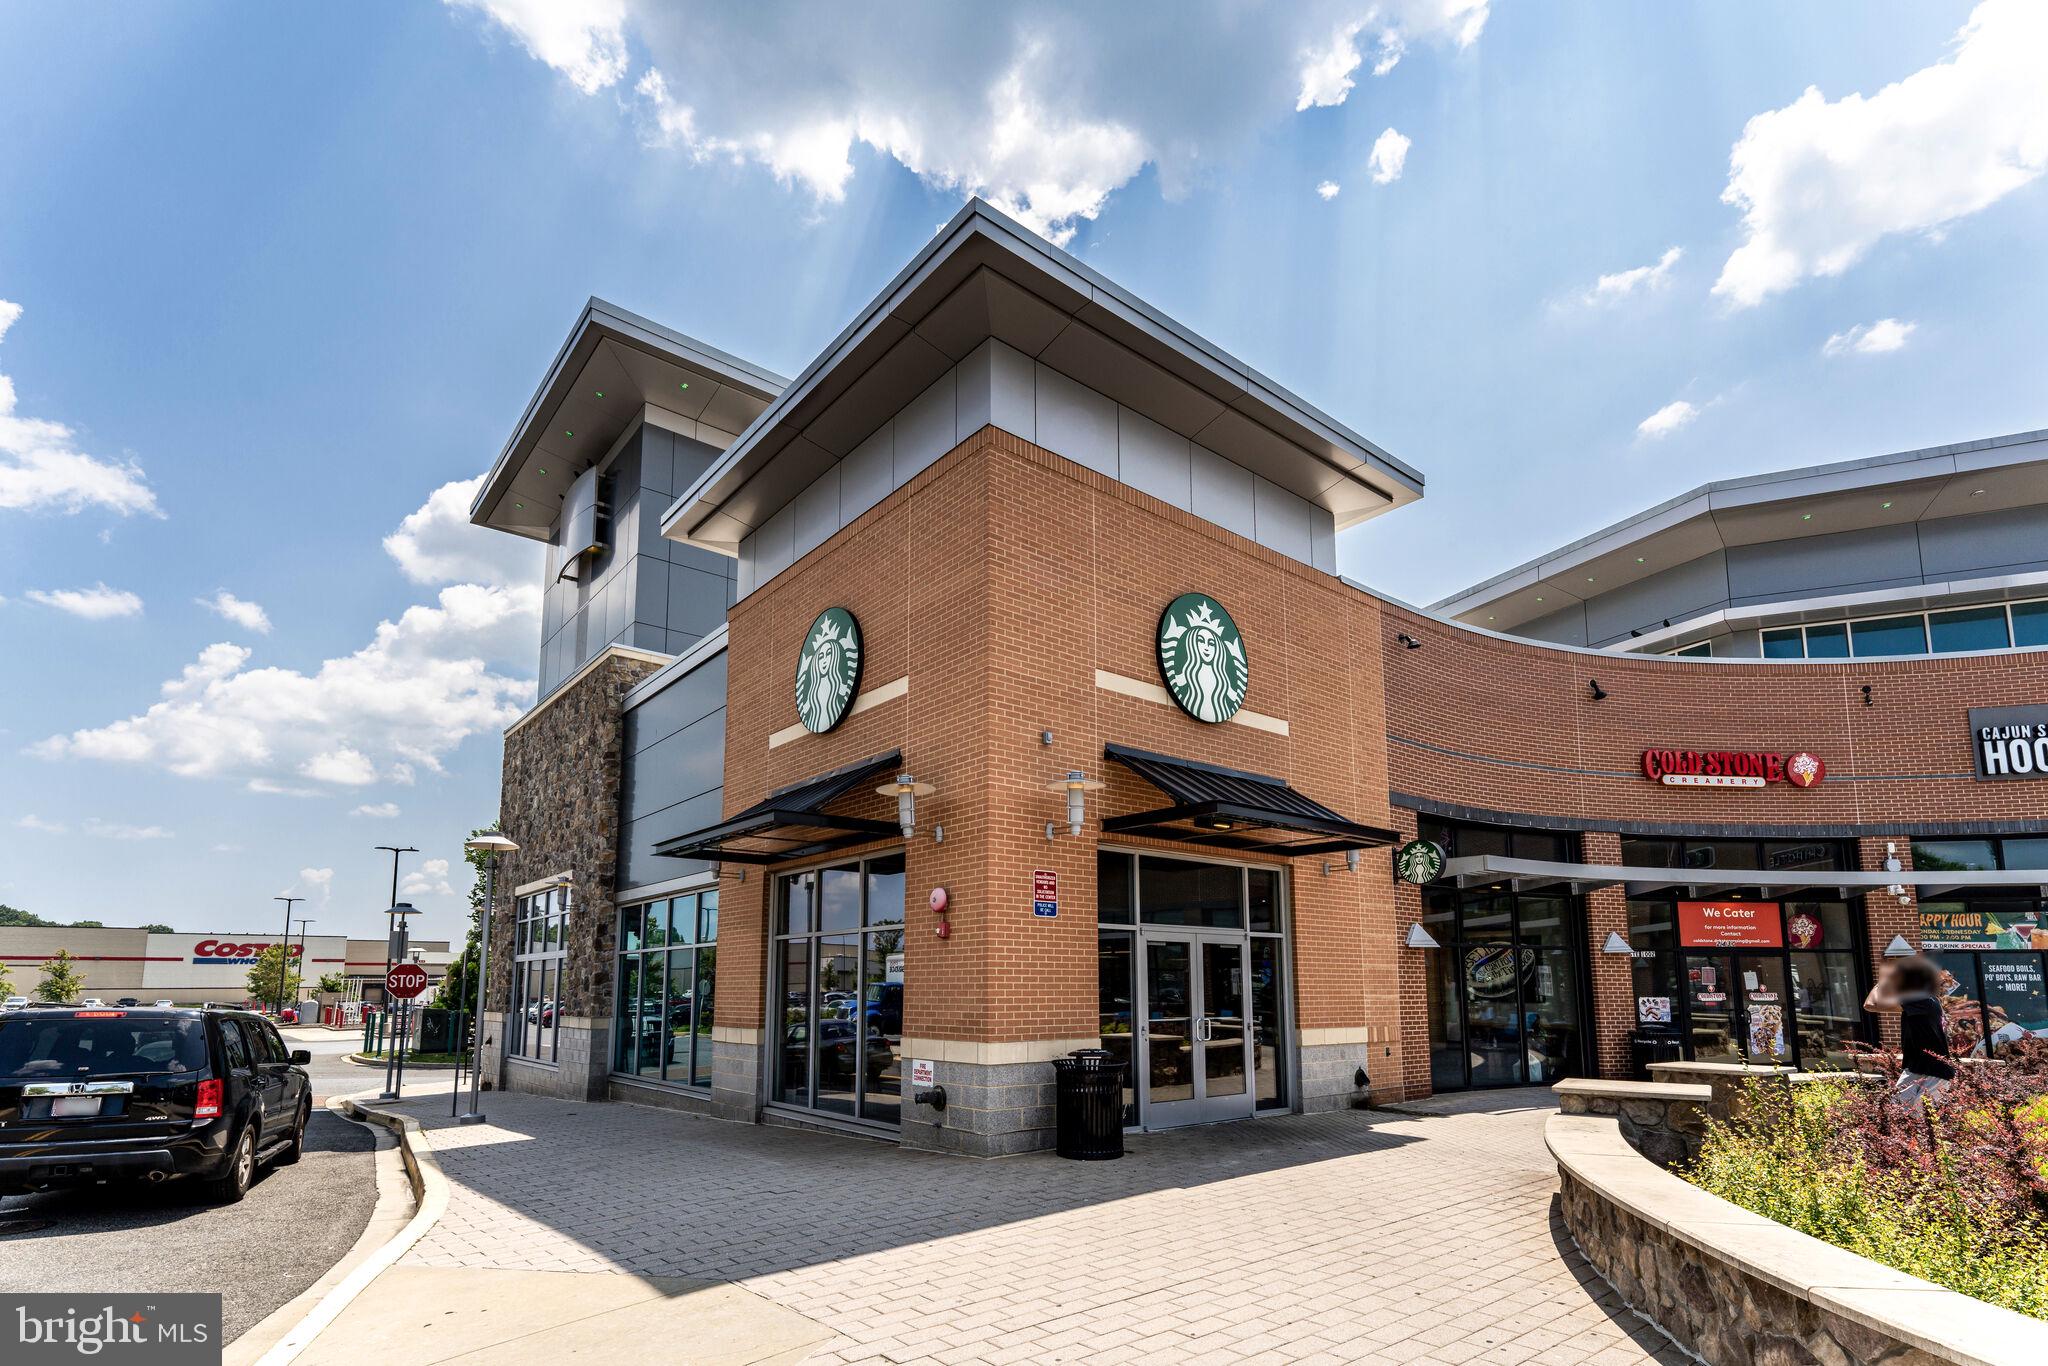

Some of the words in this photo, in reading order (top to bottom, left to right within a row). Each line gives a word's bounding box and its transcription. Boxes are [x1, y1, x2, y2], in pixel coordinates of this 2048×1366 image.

[1982, 725, 2031, 740] CAJUN
[2037, 724, 2047, 737] S
[1643, 749, 1701, 779] COLD
[1703, 751, 1784, 783] STONE
[1669, 776, 1760, 785] CREAMERY
[1702, 907, 1720, 918] We
[1723, 907, 1755, 918] Cater
[1951, 912, 1983, 928] HOUR
[194, 940, 305, 958] COSTO
[1988, 965, 2015, 973] SEAFOOD
[2016, 965, 2036, 973] BOILS,
[388, 974, 425, 988] STOP
[1995, 974, 2014, 982] BOYS,
[2005, 983, 2028, 991] MORE!
